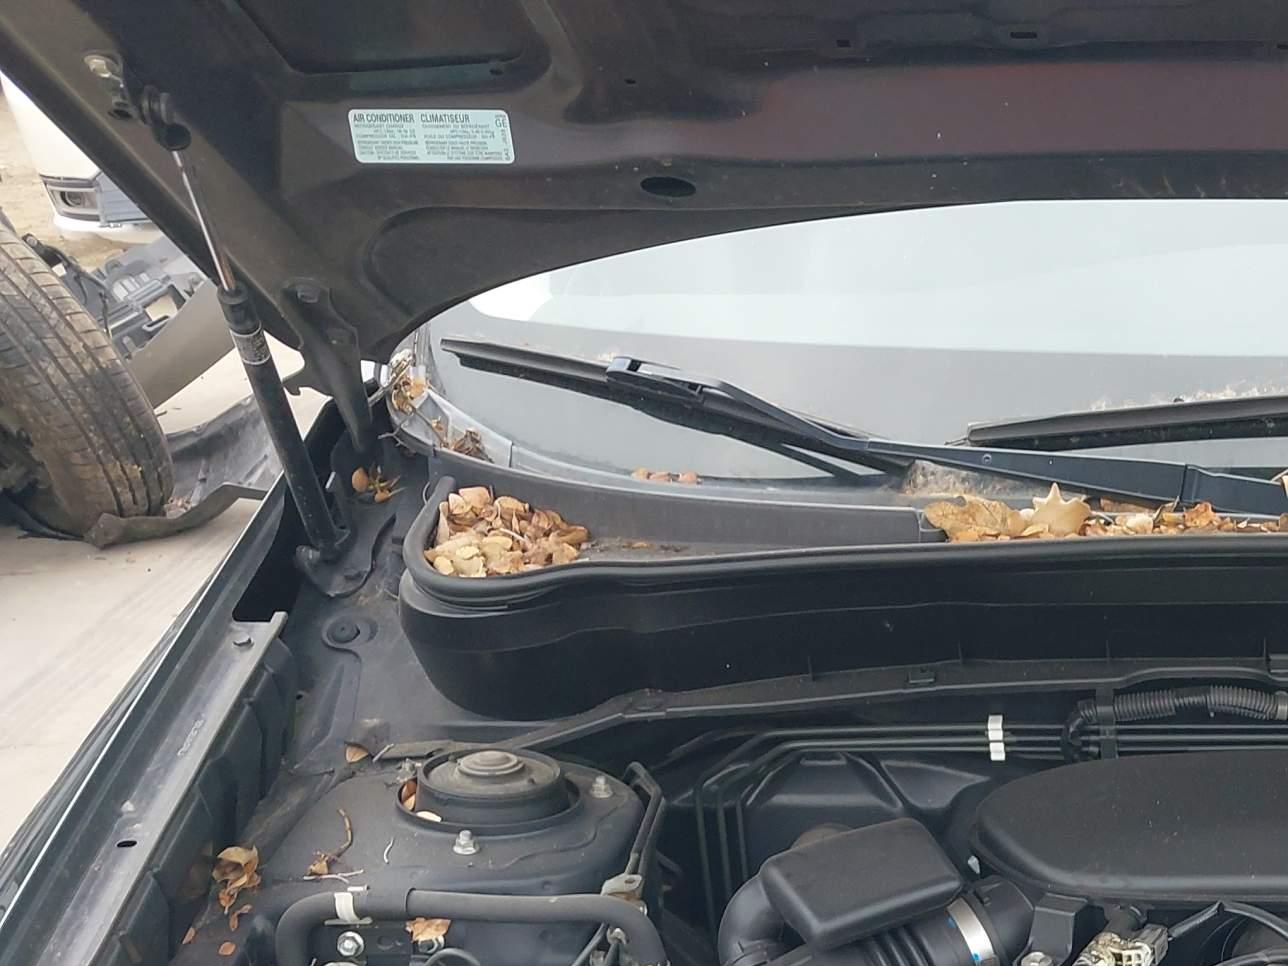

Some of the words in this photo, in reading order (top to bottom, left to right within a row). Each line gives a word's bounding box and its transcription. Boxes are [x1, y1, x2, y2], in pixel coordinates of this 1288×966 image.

[353, 113, 365, 123] AIR
[366, 113, 415, 123] CONDITIONER
[420, 113, 470, 123] CLIMATISEUR
